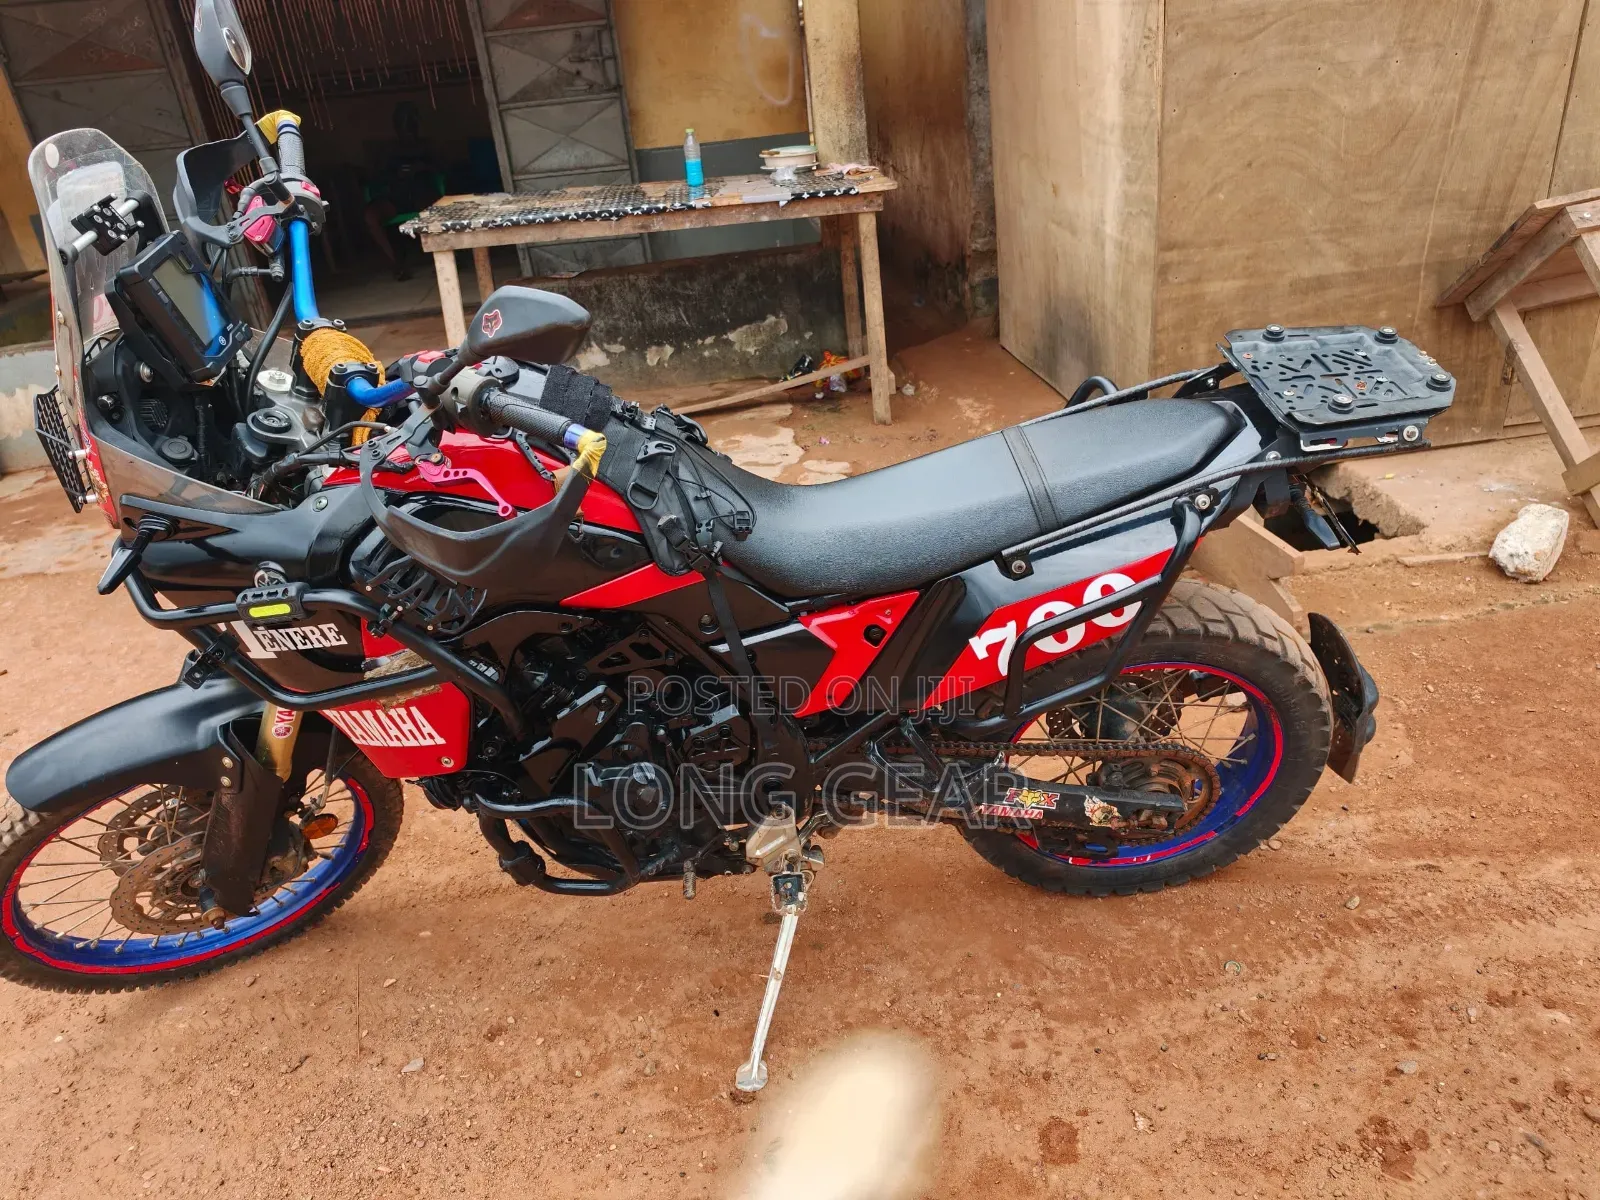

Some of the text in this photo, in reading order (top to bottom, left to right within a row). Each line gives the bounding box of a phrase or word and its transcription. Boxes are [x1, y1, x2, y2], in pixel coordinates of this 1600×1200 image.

[968, 572, 1142, 677] 700
[321, 705, 447, 748] YAMAHA
[980, 803, 1044, 820] YAMAHA
